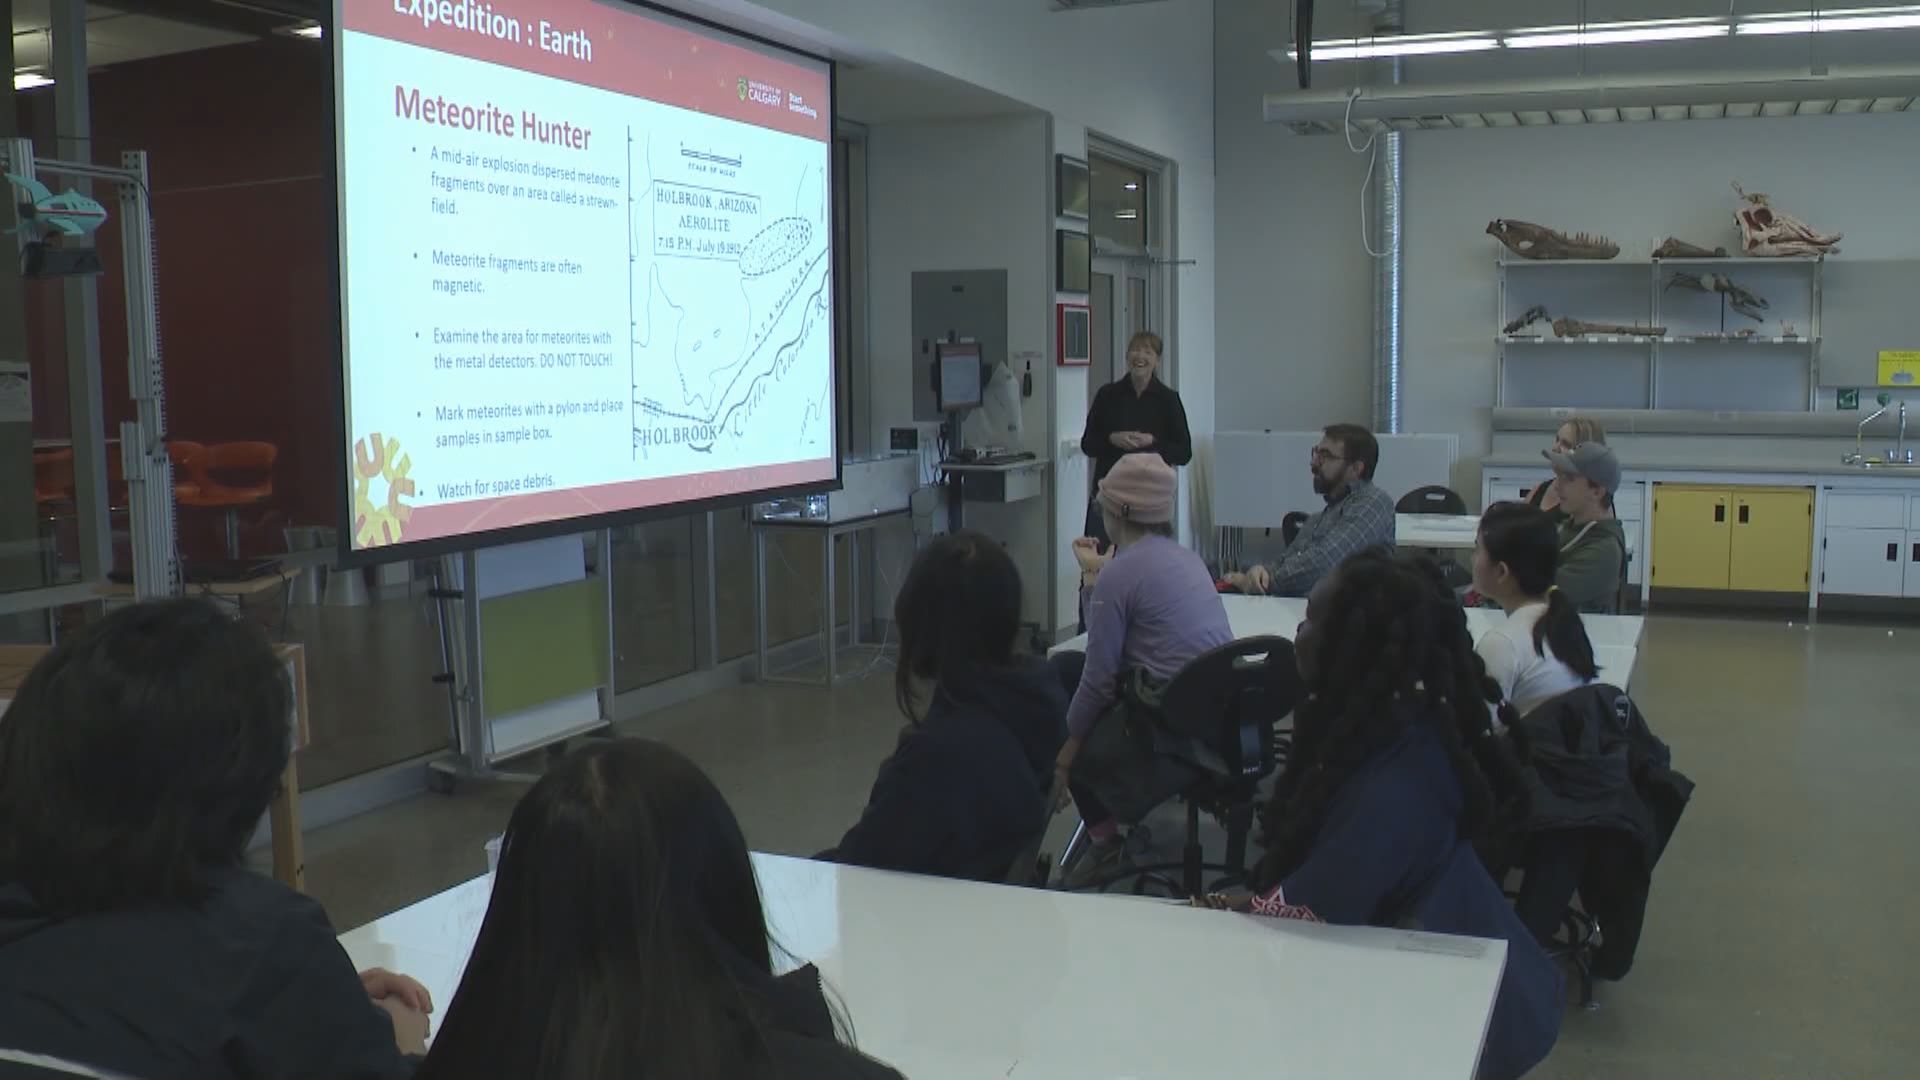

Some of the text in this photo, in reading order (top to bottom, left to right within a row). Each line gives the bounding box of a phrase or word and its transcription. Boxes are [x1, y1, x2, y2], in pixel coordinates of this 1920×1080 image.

[538, 19, 592, 63] Earth
[748, 88, 781, 107] CALGARY
[394, 84, 592, 151] Meteorite Hunter
[430, 144, 620, 188] A mid-air explosion dispersed meteorite
[430, 170, 485, 193] fragments
[487, 182, 510, 196] over
[512, 185, 525, 198] an
[527, 187, 548, 201] area
[550, 188, 577, 205] called
[579, 194, 585, 206] a
[431, 196, 459, 216] field.
[718, 197, 758, 215] ARIZONA
[678, 214, 731, 233] AEROLITE
[432, 249, 583, 275] Meteorite fragments are often
[432, 277, 486, 296] magnetic.
[433, 326, 613, 346] Examine the area for meteorites with
[433, 351, 613, 370] the metal detectors. DO NOT TOUCH!
[435, 405, 464, 422] Mark
[466, 402, 523, 421] meteorites
[524, 401, 546, 418] with
[547, 404, 554, 416] a
[555, 400, 581, 418] pylon
[582, 398, 600, 415] and
[601, 398, 625, 416] place
[435, 426, 553, 449] samples in sample box.
[642, 423, 717, 446] HOLBROOK
[436, 472, 556, 500] Watch for space debris.
